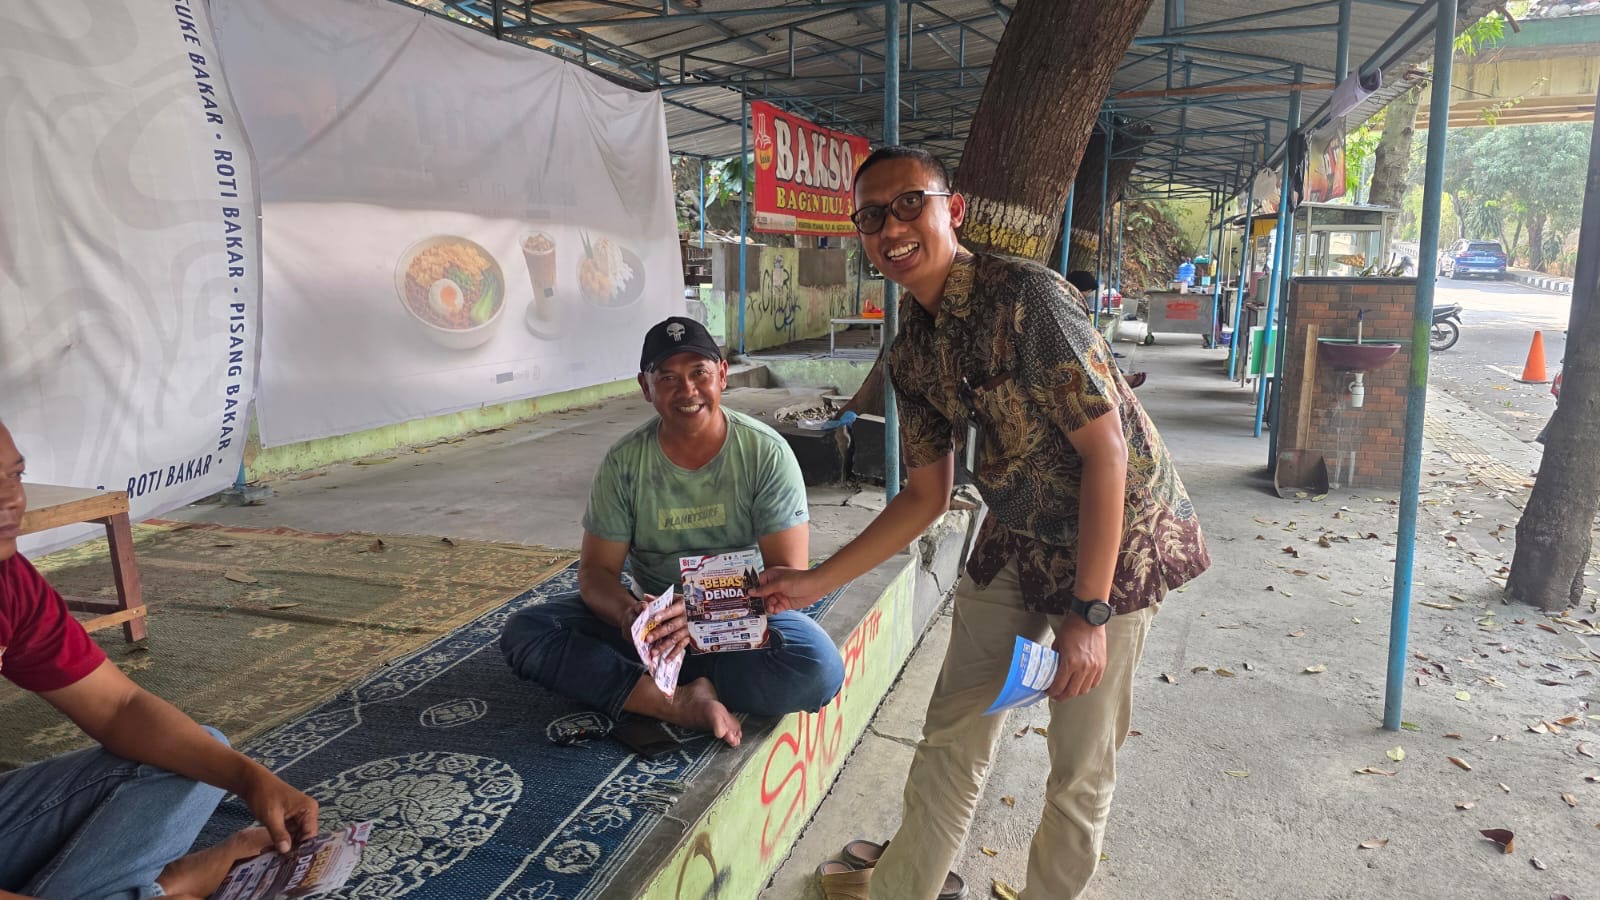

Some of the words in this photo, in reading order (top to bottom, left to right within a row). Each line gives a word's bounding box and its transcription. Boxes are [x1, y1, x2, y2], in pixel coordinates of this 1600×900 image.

[187, 51, 224, 125] BAKAR
[213, 149, 238, 198] ROTI
[774, 118, 852, 192] BAKSO
[222, 206, 245, 278] BAKAR
[228, 302, 246, 377] PISANG
[218, 384, 241, 452] BAKAR
[127, 469, 163, 499] ROTI
[165, 454, 213, 488] BAKAR
[704, 588, 745, 601] DENDA
